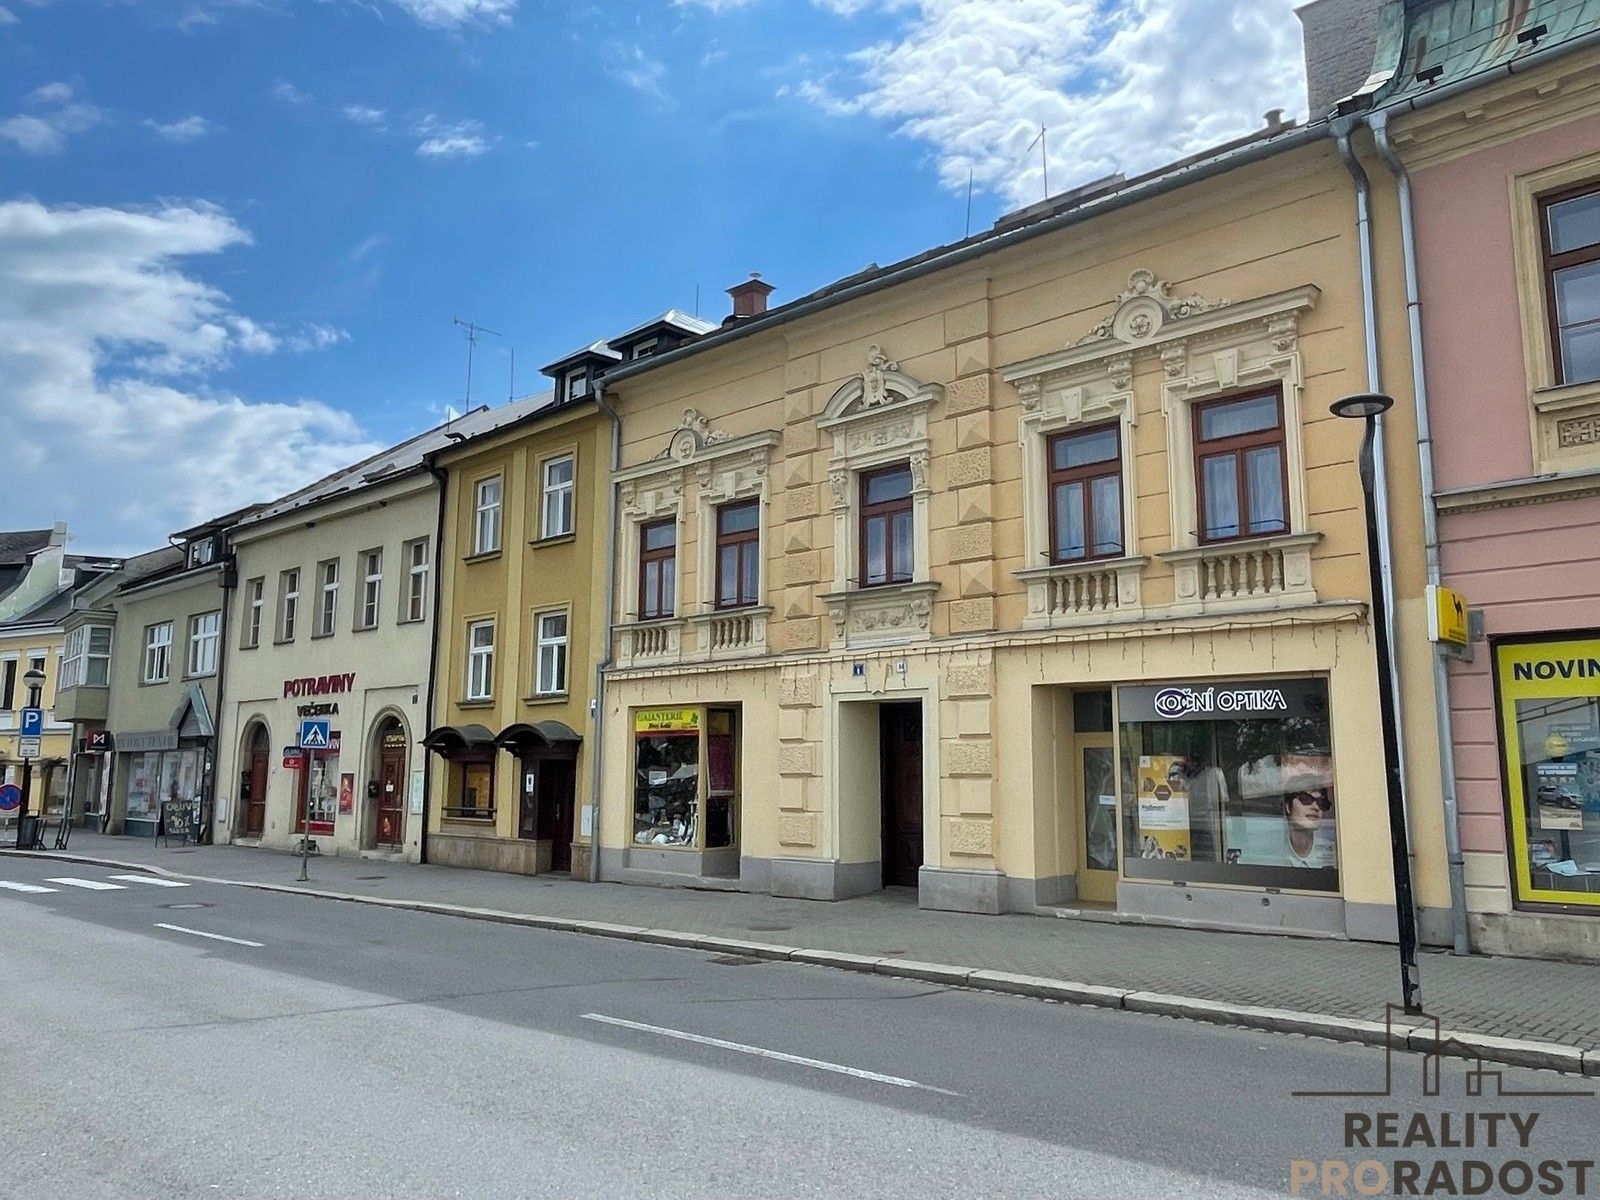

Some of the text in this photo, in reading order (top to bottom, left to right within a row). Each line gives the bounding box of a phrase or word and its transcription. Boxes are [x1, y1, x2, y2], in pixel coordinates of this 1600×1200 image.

[283, 673, 356, 698] POTRAVINY
[1157, 687, 1287, 715] OČNÍ OPTIKA
[25, 712, 39, 728] P
